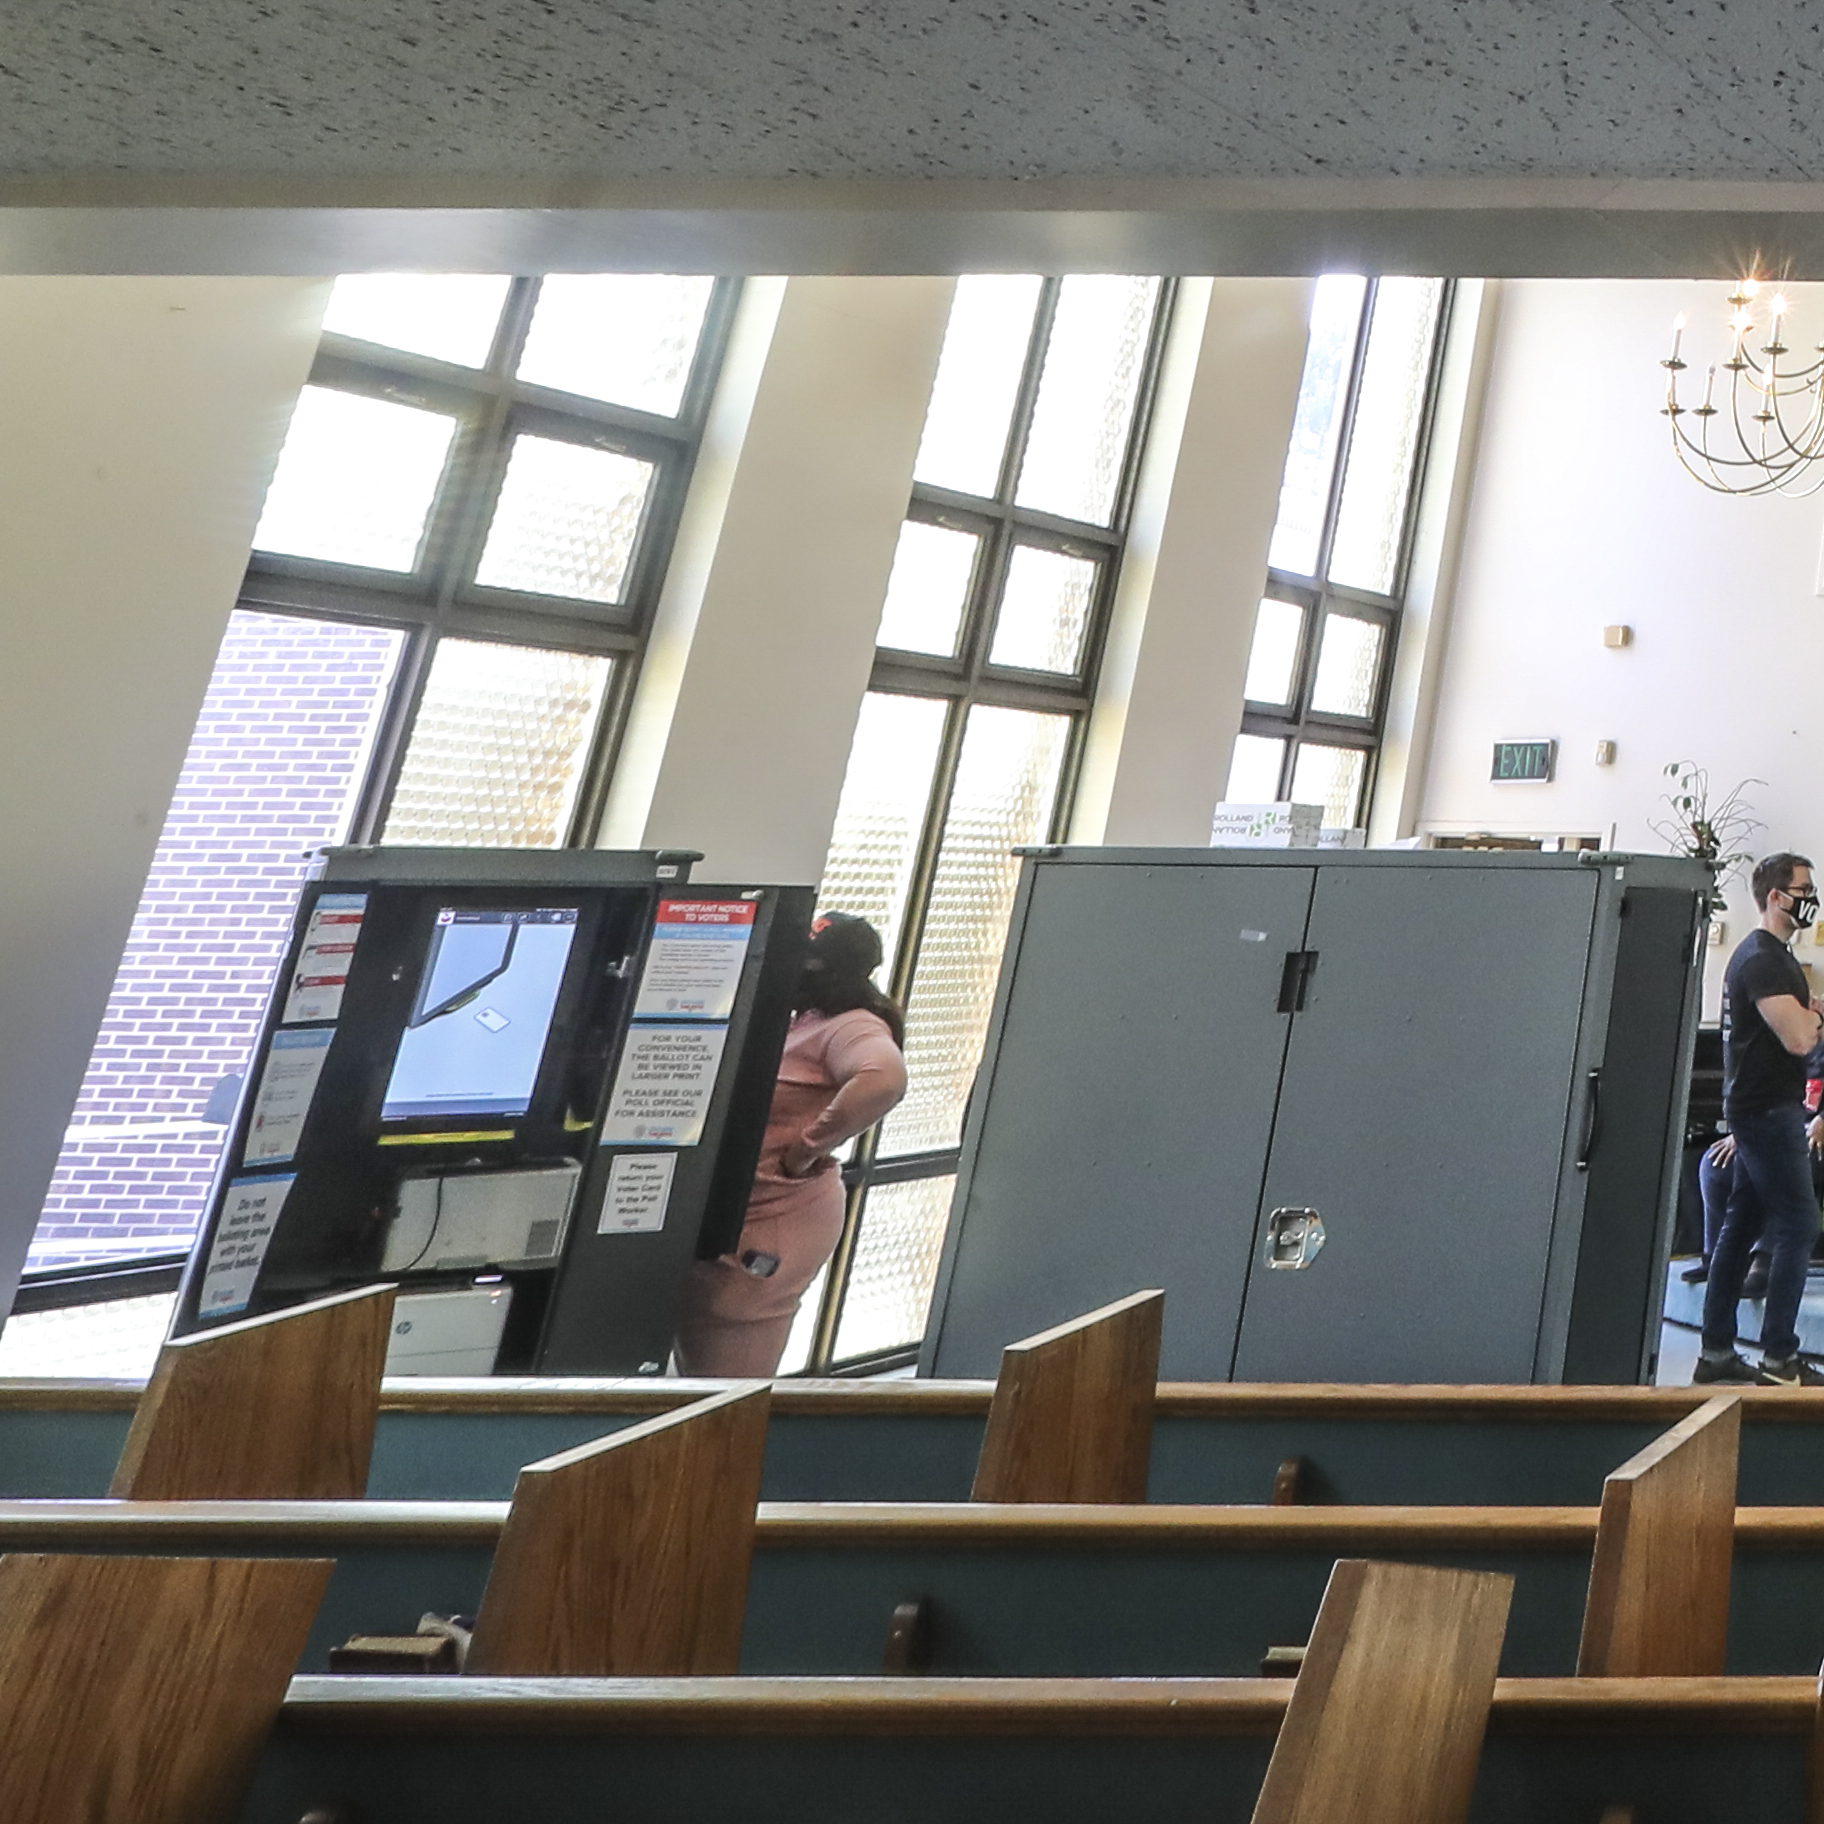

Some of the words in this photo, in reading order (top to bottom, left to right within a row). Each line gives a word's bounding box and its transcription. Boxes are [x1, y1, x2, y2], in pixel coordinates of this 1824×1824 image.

[1500, 744, 1543, 777] EXIT
[668, 903, 718, 913] IMPORTANT
[718, 904, 749, 914] NOTICE
[684, 913, 696, 922] TO
[697, 913, 730, 922] VOTERS
[622, 1089, 659, 1097] PLEASE
[662, 1089, 679, 1097] SEE
[681, 1089, 703, 1097] OUR
